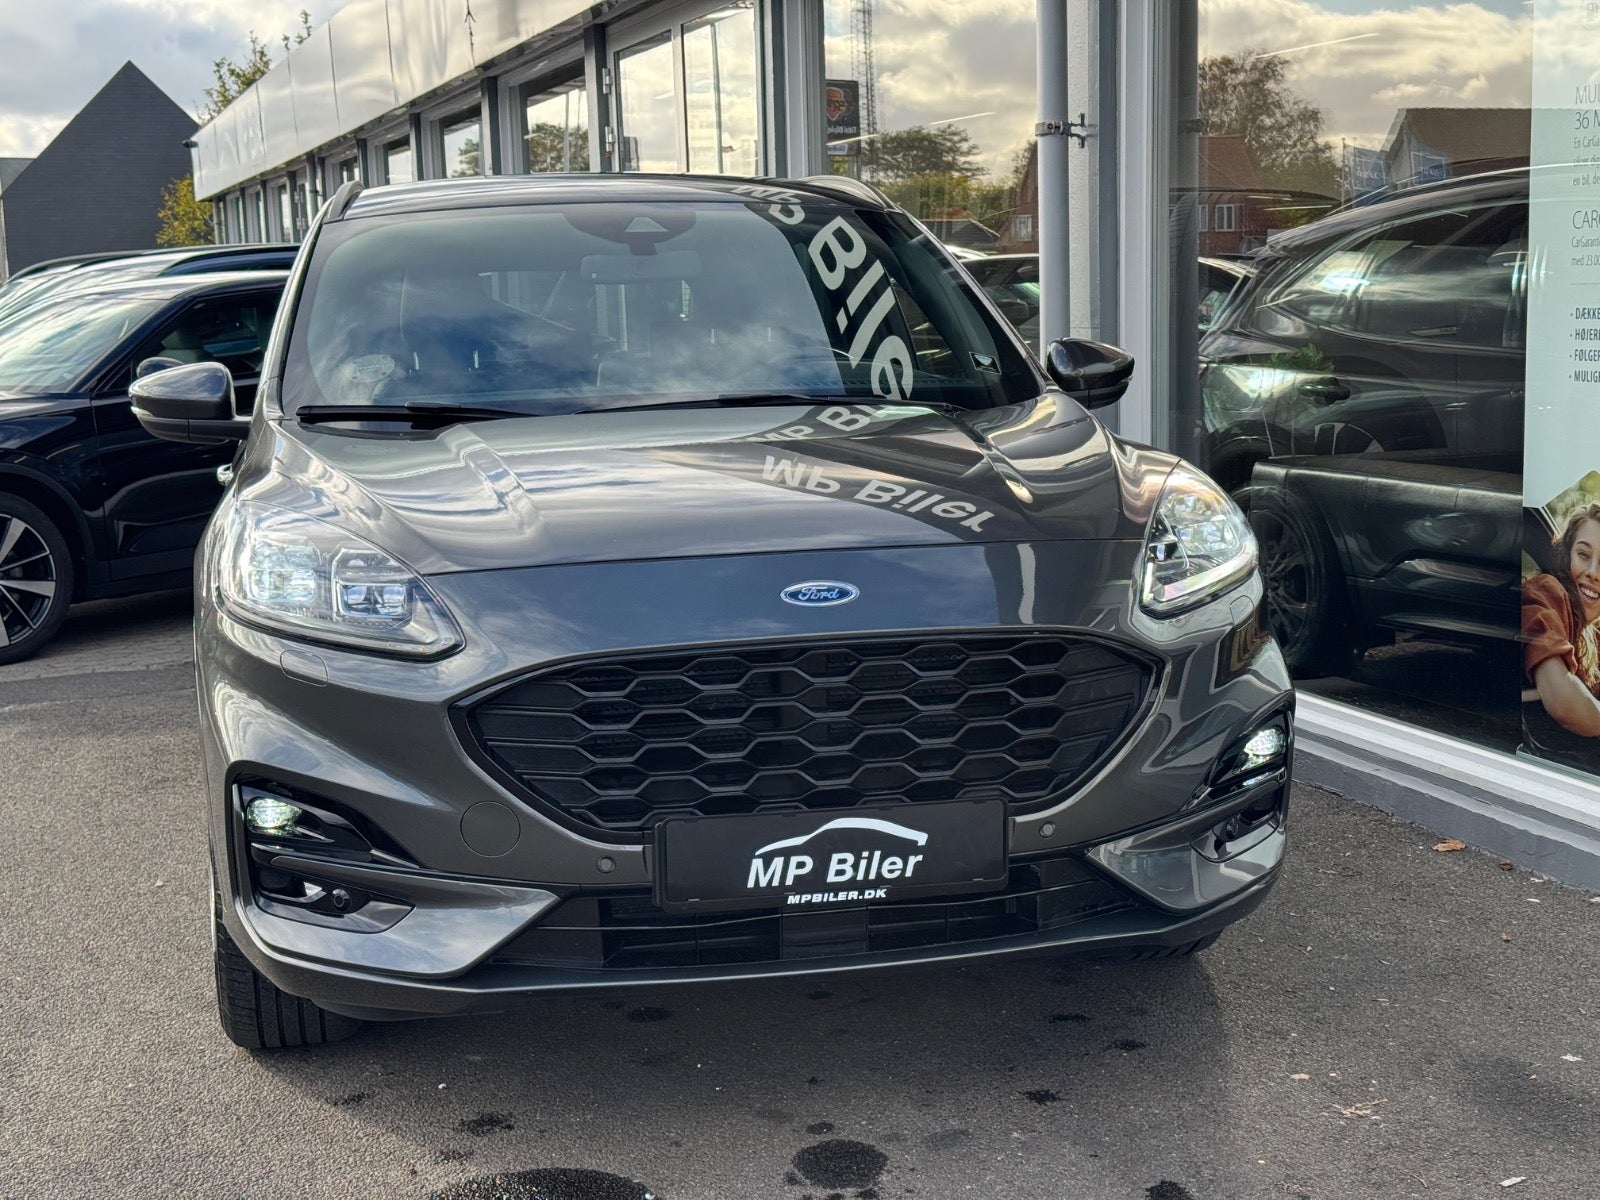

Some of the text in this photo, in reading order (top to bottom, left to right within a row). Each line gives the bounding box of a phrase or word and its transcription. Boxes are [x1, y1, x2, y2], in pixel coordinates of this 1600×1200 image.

[1574, 110, 1590, 130] 36
[1573, 209, 1600, 229] CAR
[1575, 328, 1600, 341] HØJER
[1573, 369, 1600, 383] MULIG
[798, 586, 840, 601] Ford
[747, 850, 924, 889] MP Biler
[787, 888, 888, 905] MPBILER.DK
